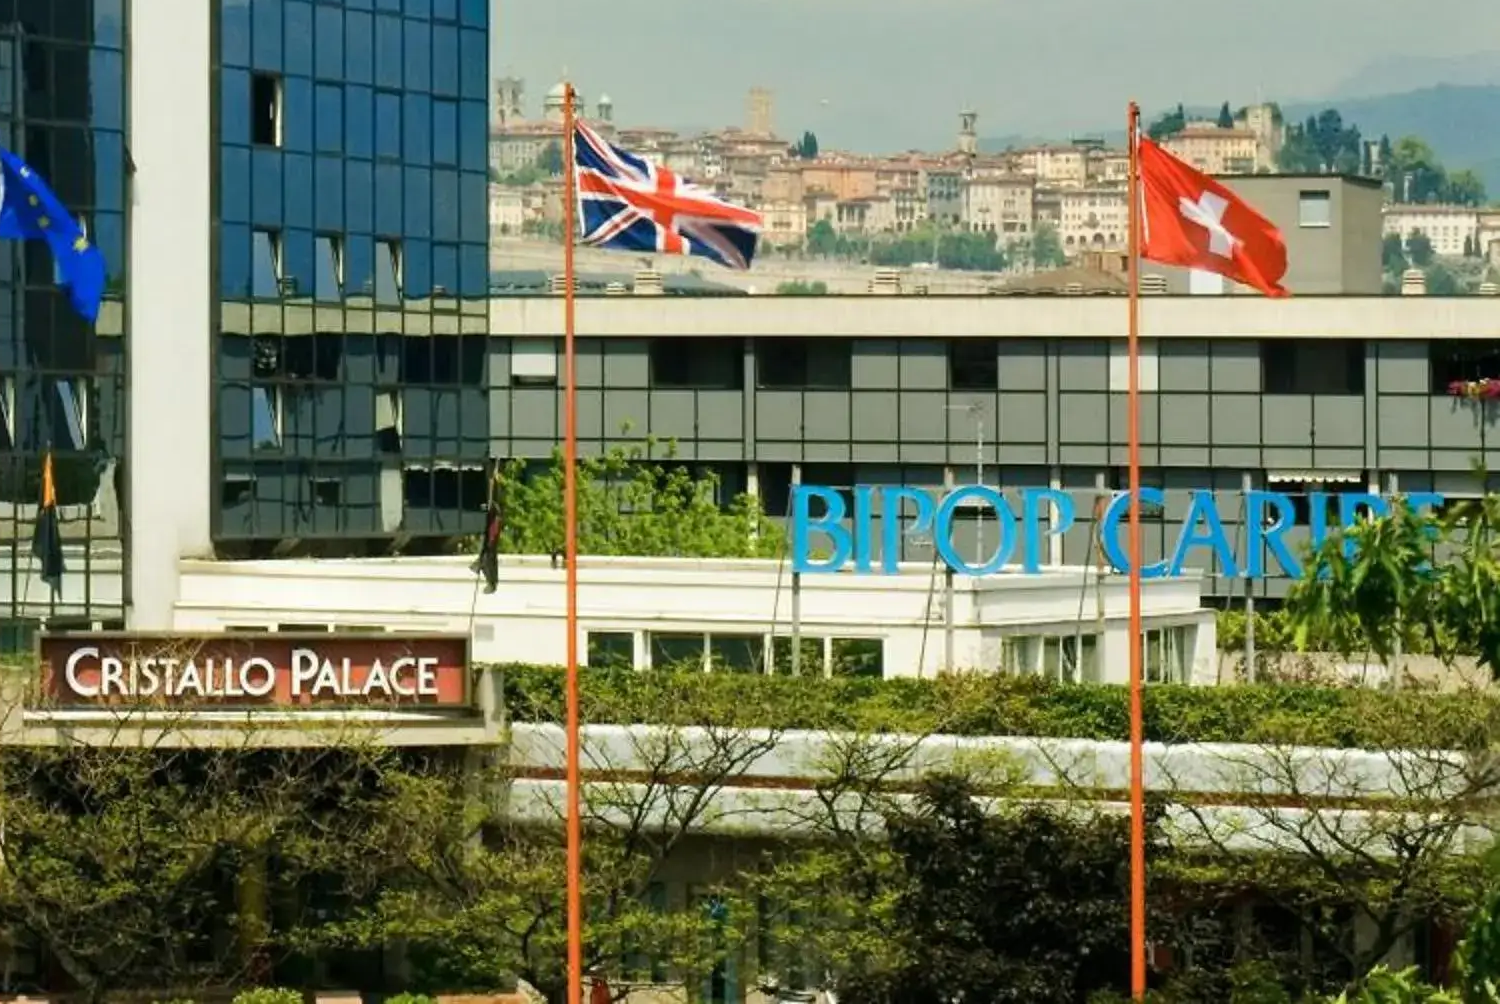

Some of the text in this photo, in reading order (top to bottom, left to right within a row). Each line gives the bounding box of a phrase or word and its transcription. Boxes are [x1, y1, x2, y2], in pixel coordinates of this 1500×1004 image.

[792, 484, 1075, 575] BIPOP
[65, 646, 439, 696] CRISTALLO PALACE
